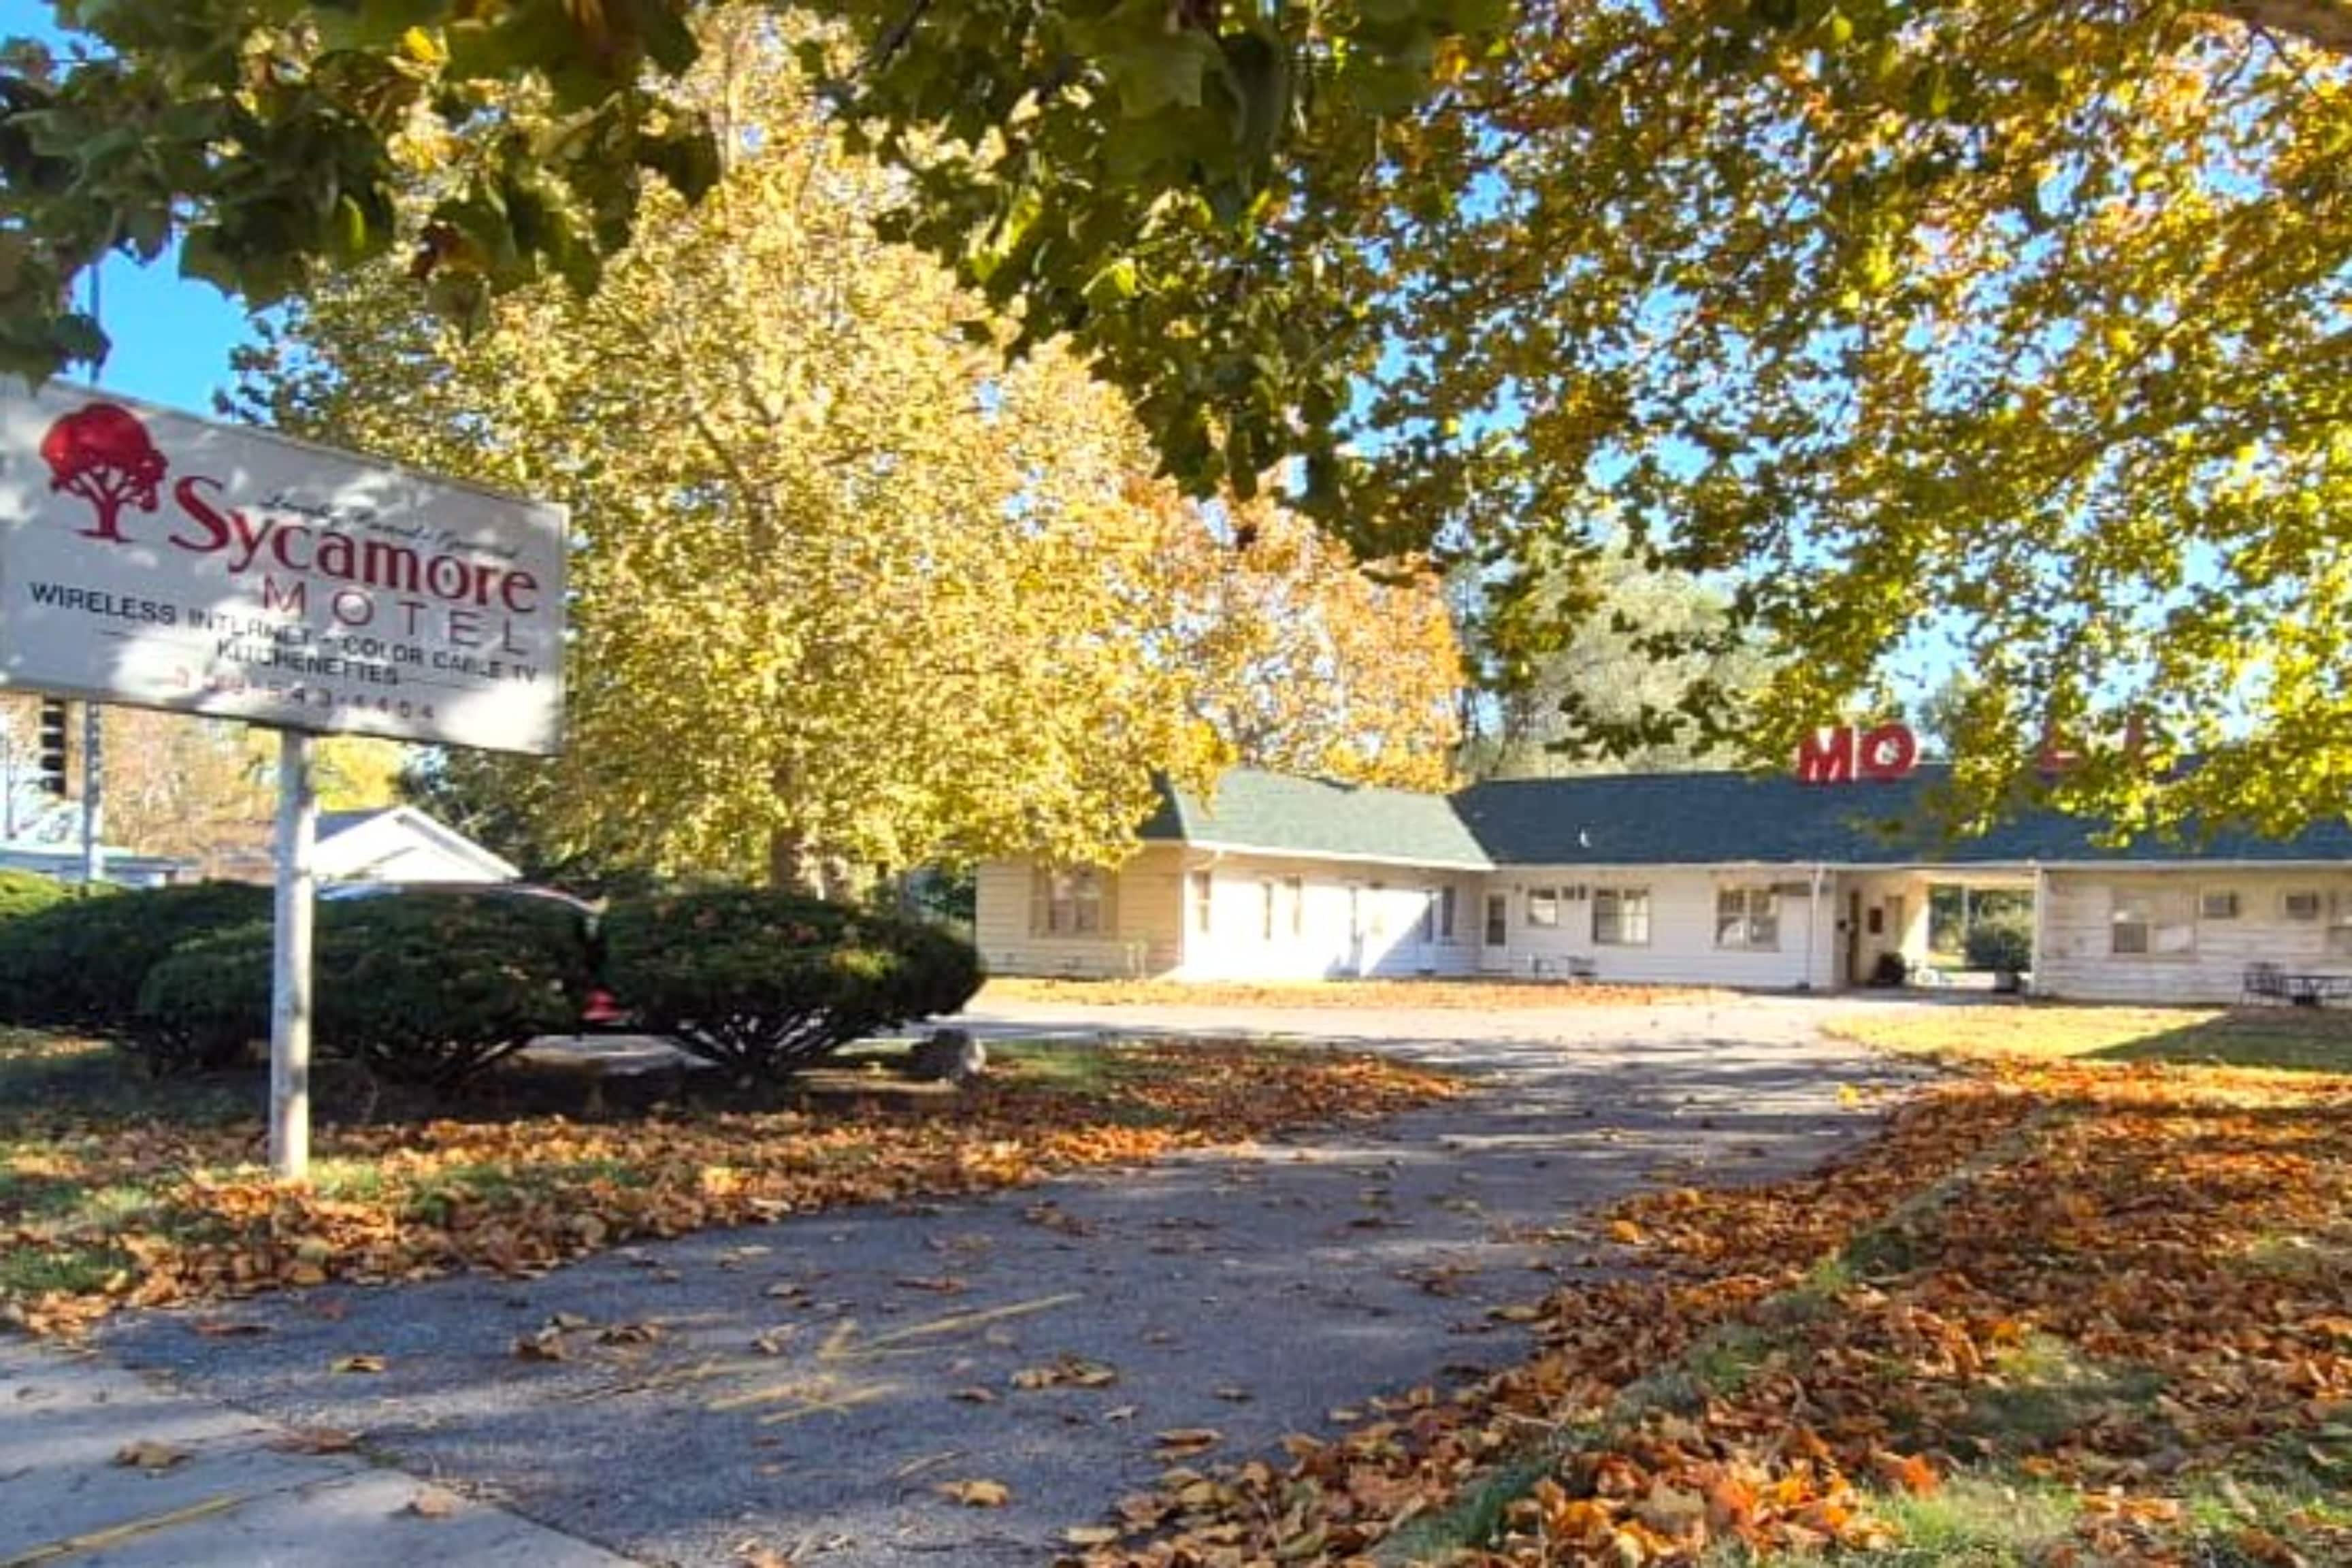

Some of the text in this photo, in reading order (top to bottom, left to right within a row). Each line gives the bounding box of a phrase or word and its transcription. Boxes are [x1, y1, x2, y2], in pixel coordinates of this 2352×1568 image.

[168, 475, 538, 614] Sycamore
[30, 582, 176, 626] WIRELESS
[342, 635, 423, 666] COLOR
[433, 651, 503, 679] CABLE
[512, 663, 537, 685] TV
[263, 573, 529, 656] MOTEL
